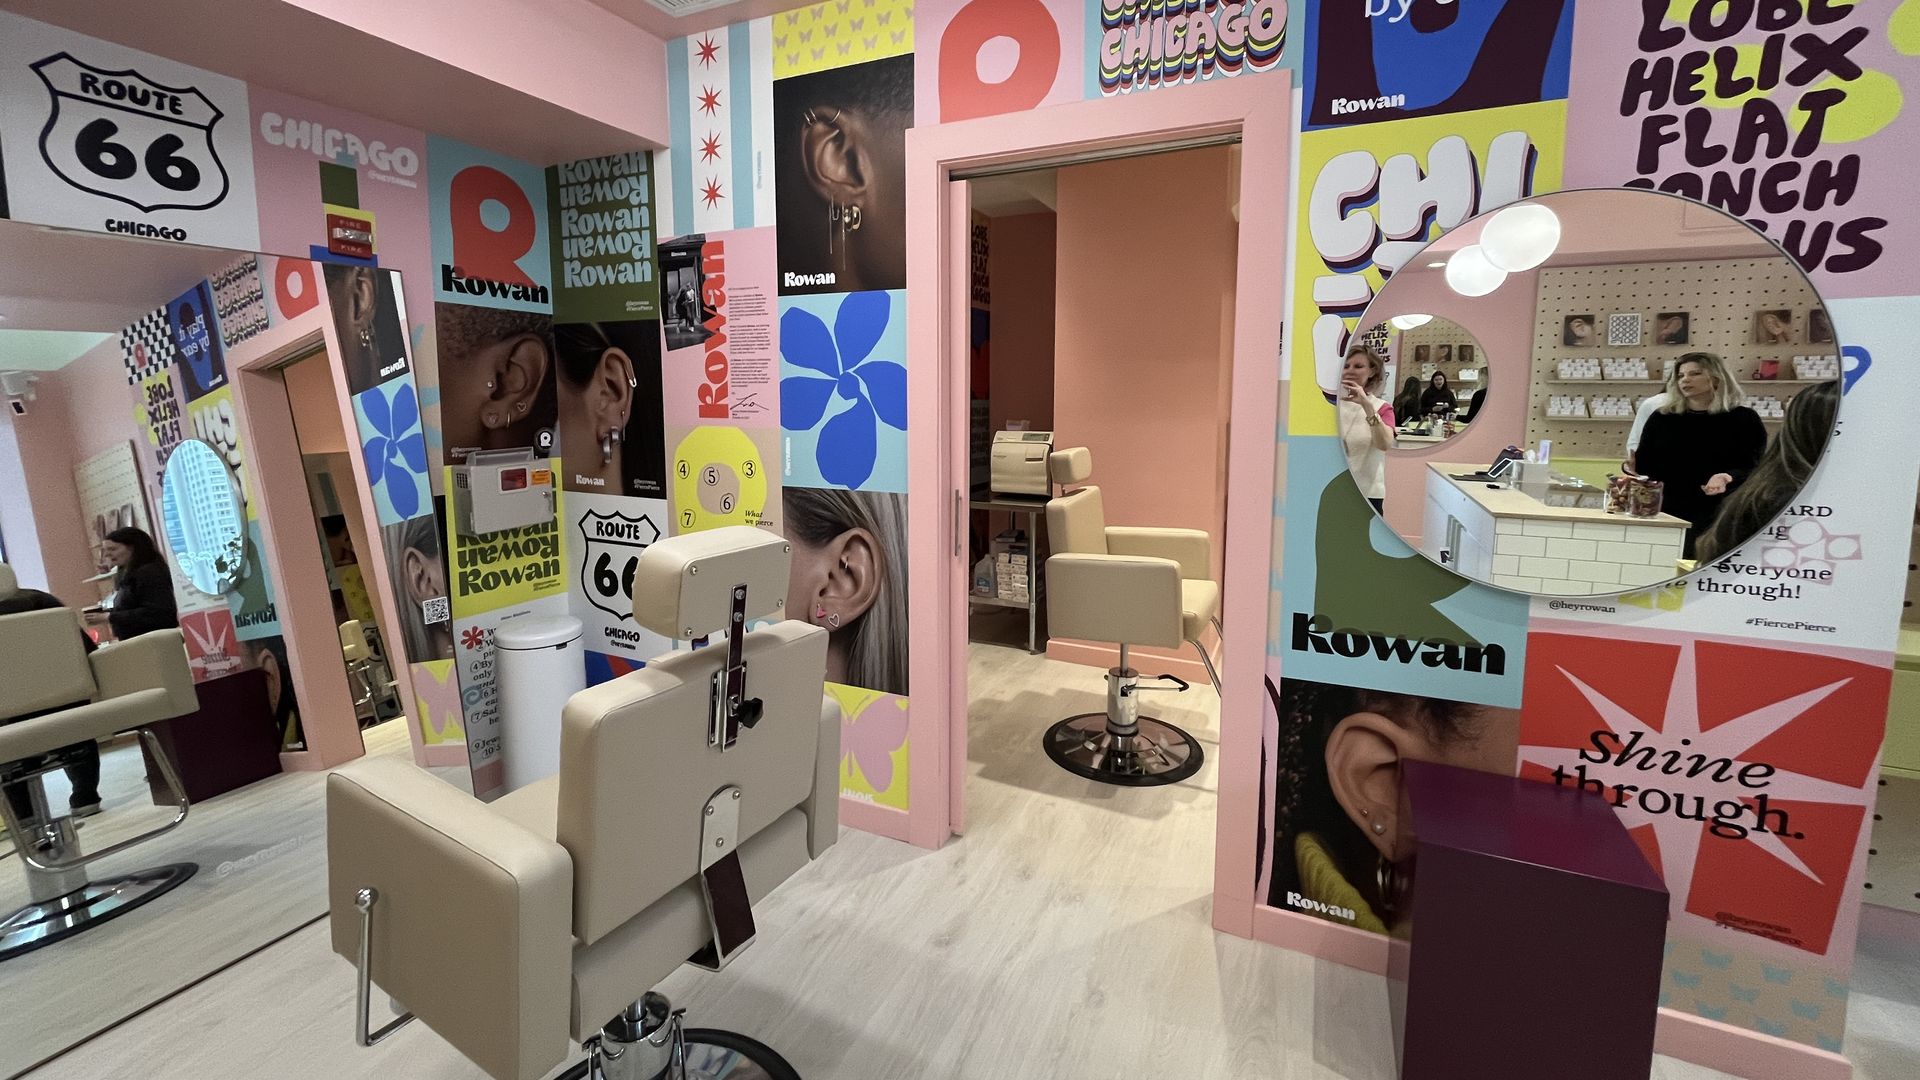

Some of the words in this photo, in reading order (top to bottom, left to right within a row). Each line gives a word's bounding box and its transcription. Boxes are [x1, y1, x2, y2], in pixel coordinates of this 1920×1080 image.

[1099, 0, 1288, 97] CHICAGO
[1620, 26, 1870, 117] HELIX
[79, 71, 184, 116] ROUTE
[1331, 93, 1405, 115] Rowan
[260, 111, 419, 176] CHICAGO
[1636, 88, 1847, 175] FLAT
[75, 118, 200, 191] 66
[557, 150, 648, 185] Rowan
[1309, 131, 1538, 273] CHI
[1622, 154, 1860, 216] NCH
[105, 218, 187, 241] CHICAGO
[561, 205, 650, 238] Rowan
[442, 263, 549, 304] Rowan
[564, 260, 652, 289] Rowan
[784, 271, 836, 288] Rowan
[697, 239, 729, 419] Rowan
[575, 474, 605, 486] Rowan
[596, 520, 640, 540] ROUTE
[745, 510, 763, 518] What
[459, 559, 560, 597] Rowan
[1697, 577, 1801, 601] through!
[1718, 563, 1832, 581] everyone
[1549, 600, 1616, 614] @heyrowan
[604, 626, 641, 643] CHICAGO
[1745, 617, 1836, 634] #FiercePierce
[1291, 612, 1506, 676] Rowan
[1579, 729, 1776, 789] Shine
[1550, 763, 1805, 840] through.
[1286, 891, 1356, 921] Rowan
